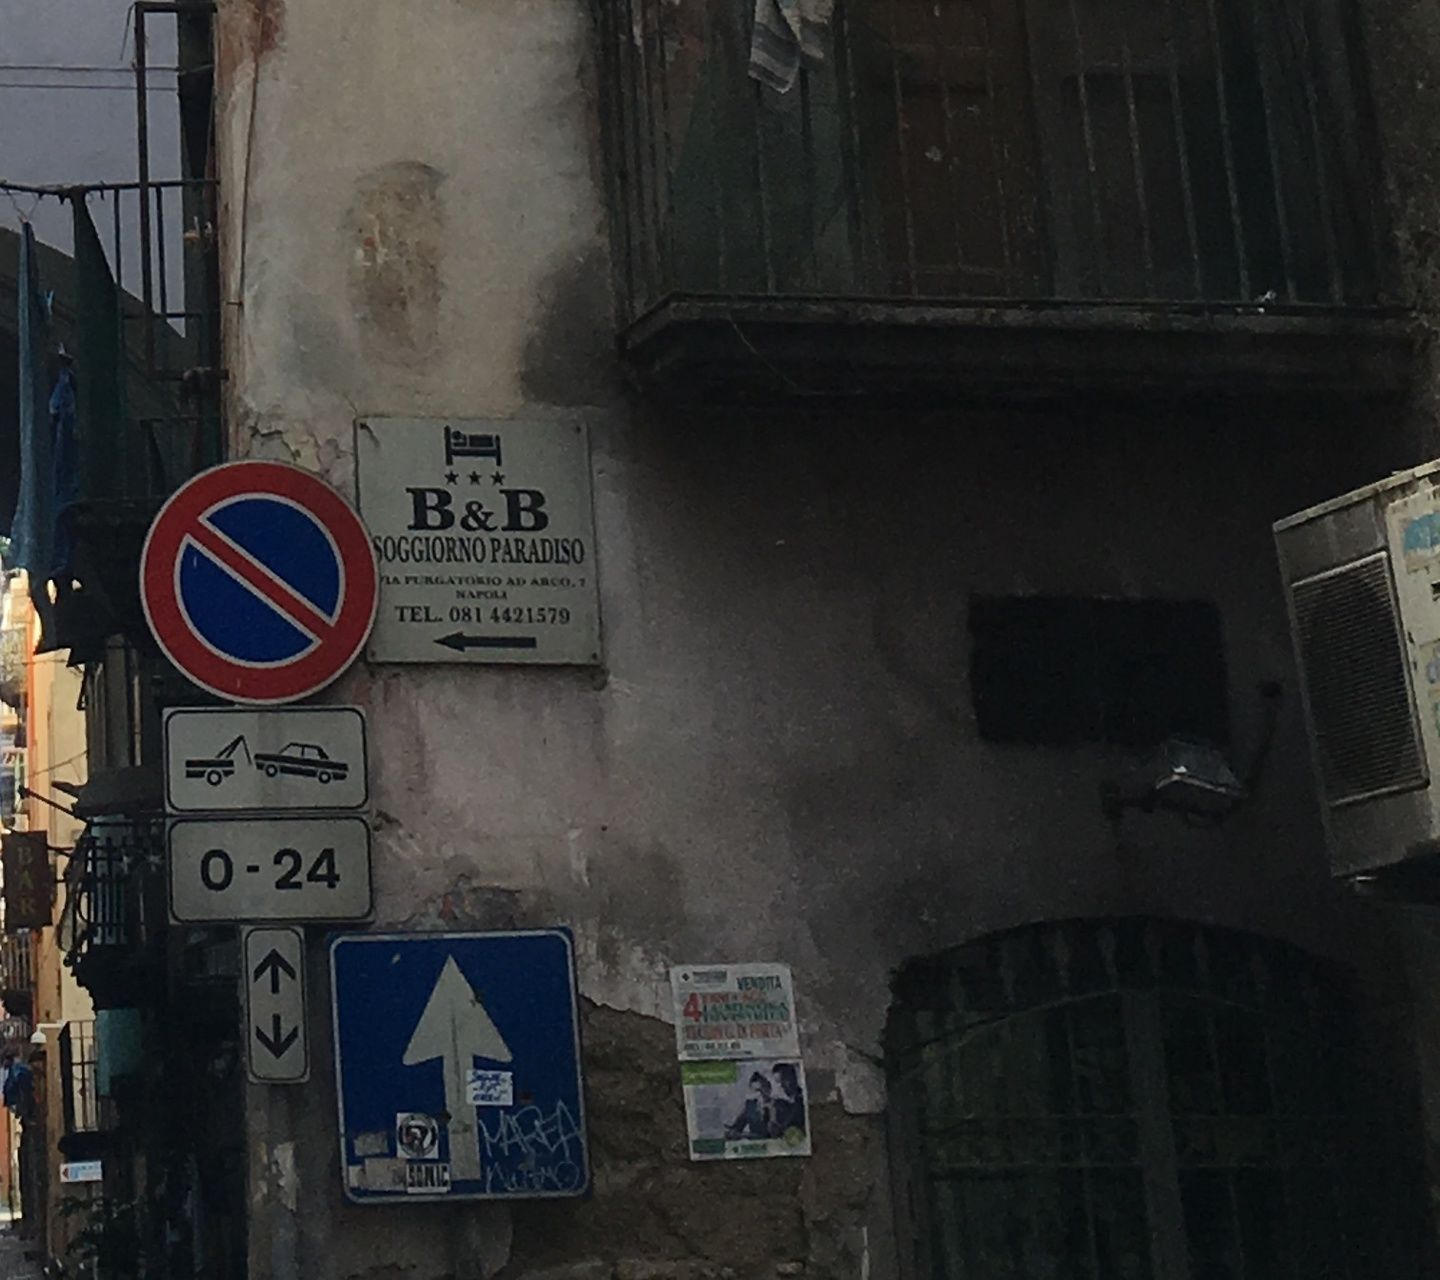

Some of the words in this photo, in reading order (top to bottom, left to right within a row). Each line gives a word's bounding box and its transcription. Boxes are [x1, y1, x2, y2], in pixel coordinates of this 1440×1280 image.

[405, 488, 549, 532] B&B
[374, 535, 486, 563] SOGGIORNO
[490, 538, 585, 564] PARADISO
[405, 574, 502, 587] PURGATORIO
[506, 576, 526, 587] AD
[456, 590, 507, 601] NAPOLI
[394, 605, 443, 623] TEL.
[448, 606, 482, 624] 081
[489, 607, 571, 625] 4421579
[200, 848, 234, 892] 0
[272, 847, 341, 890] 24
[682, 992, 702, 1022] 4
[407, 1165, 449, 1187] SONIC
